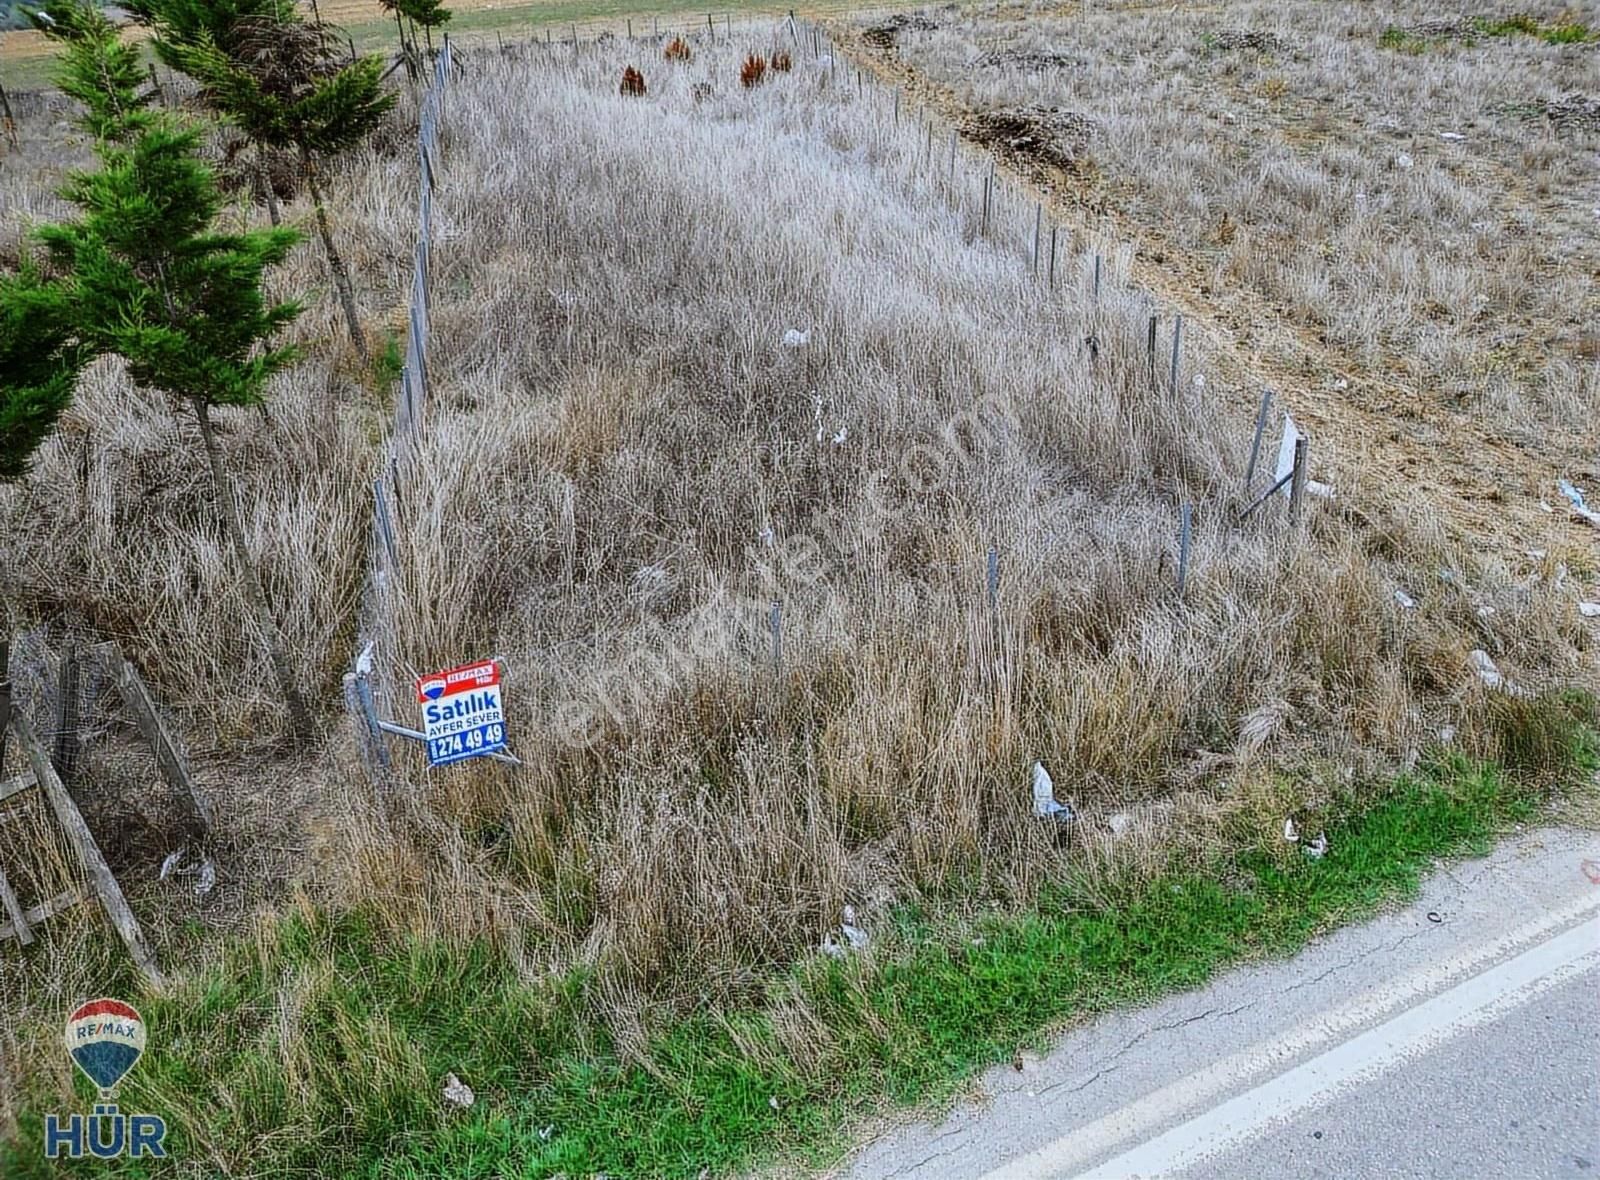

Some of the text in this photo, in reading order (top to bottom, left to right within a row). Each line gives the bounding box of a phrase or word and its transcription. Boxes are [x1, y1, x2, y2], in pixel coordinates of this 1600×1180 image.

[427, 692, 497, 723] Satılık
[429, 711, 500, 737] AYFER SEVER
[438, 735, 463, 757] 274
[466, 728, 483, 750] 49
[485, 724, 503, 744] 49
